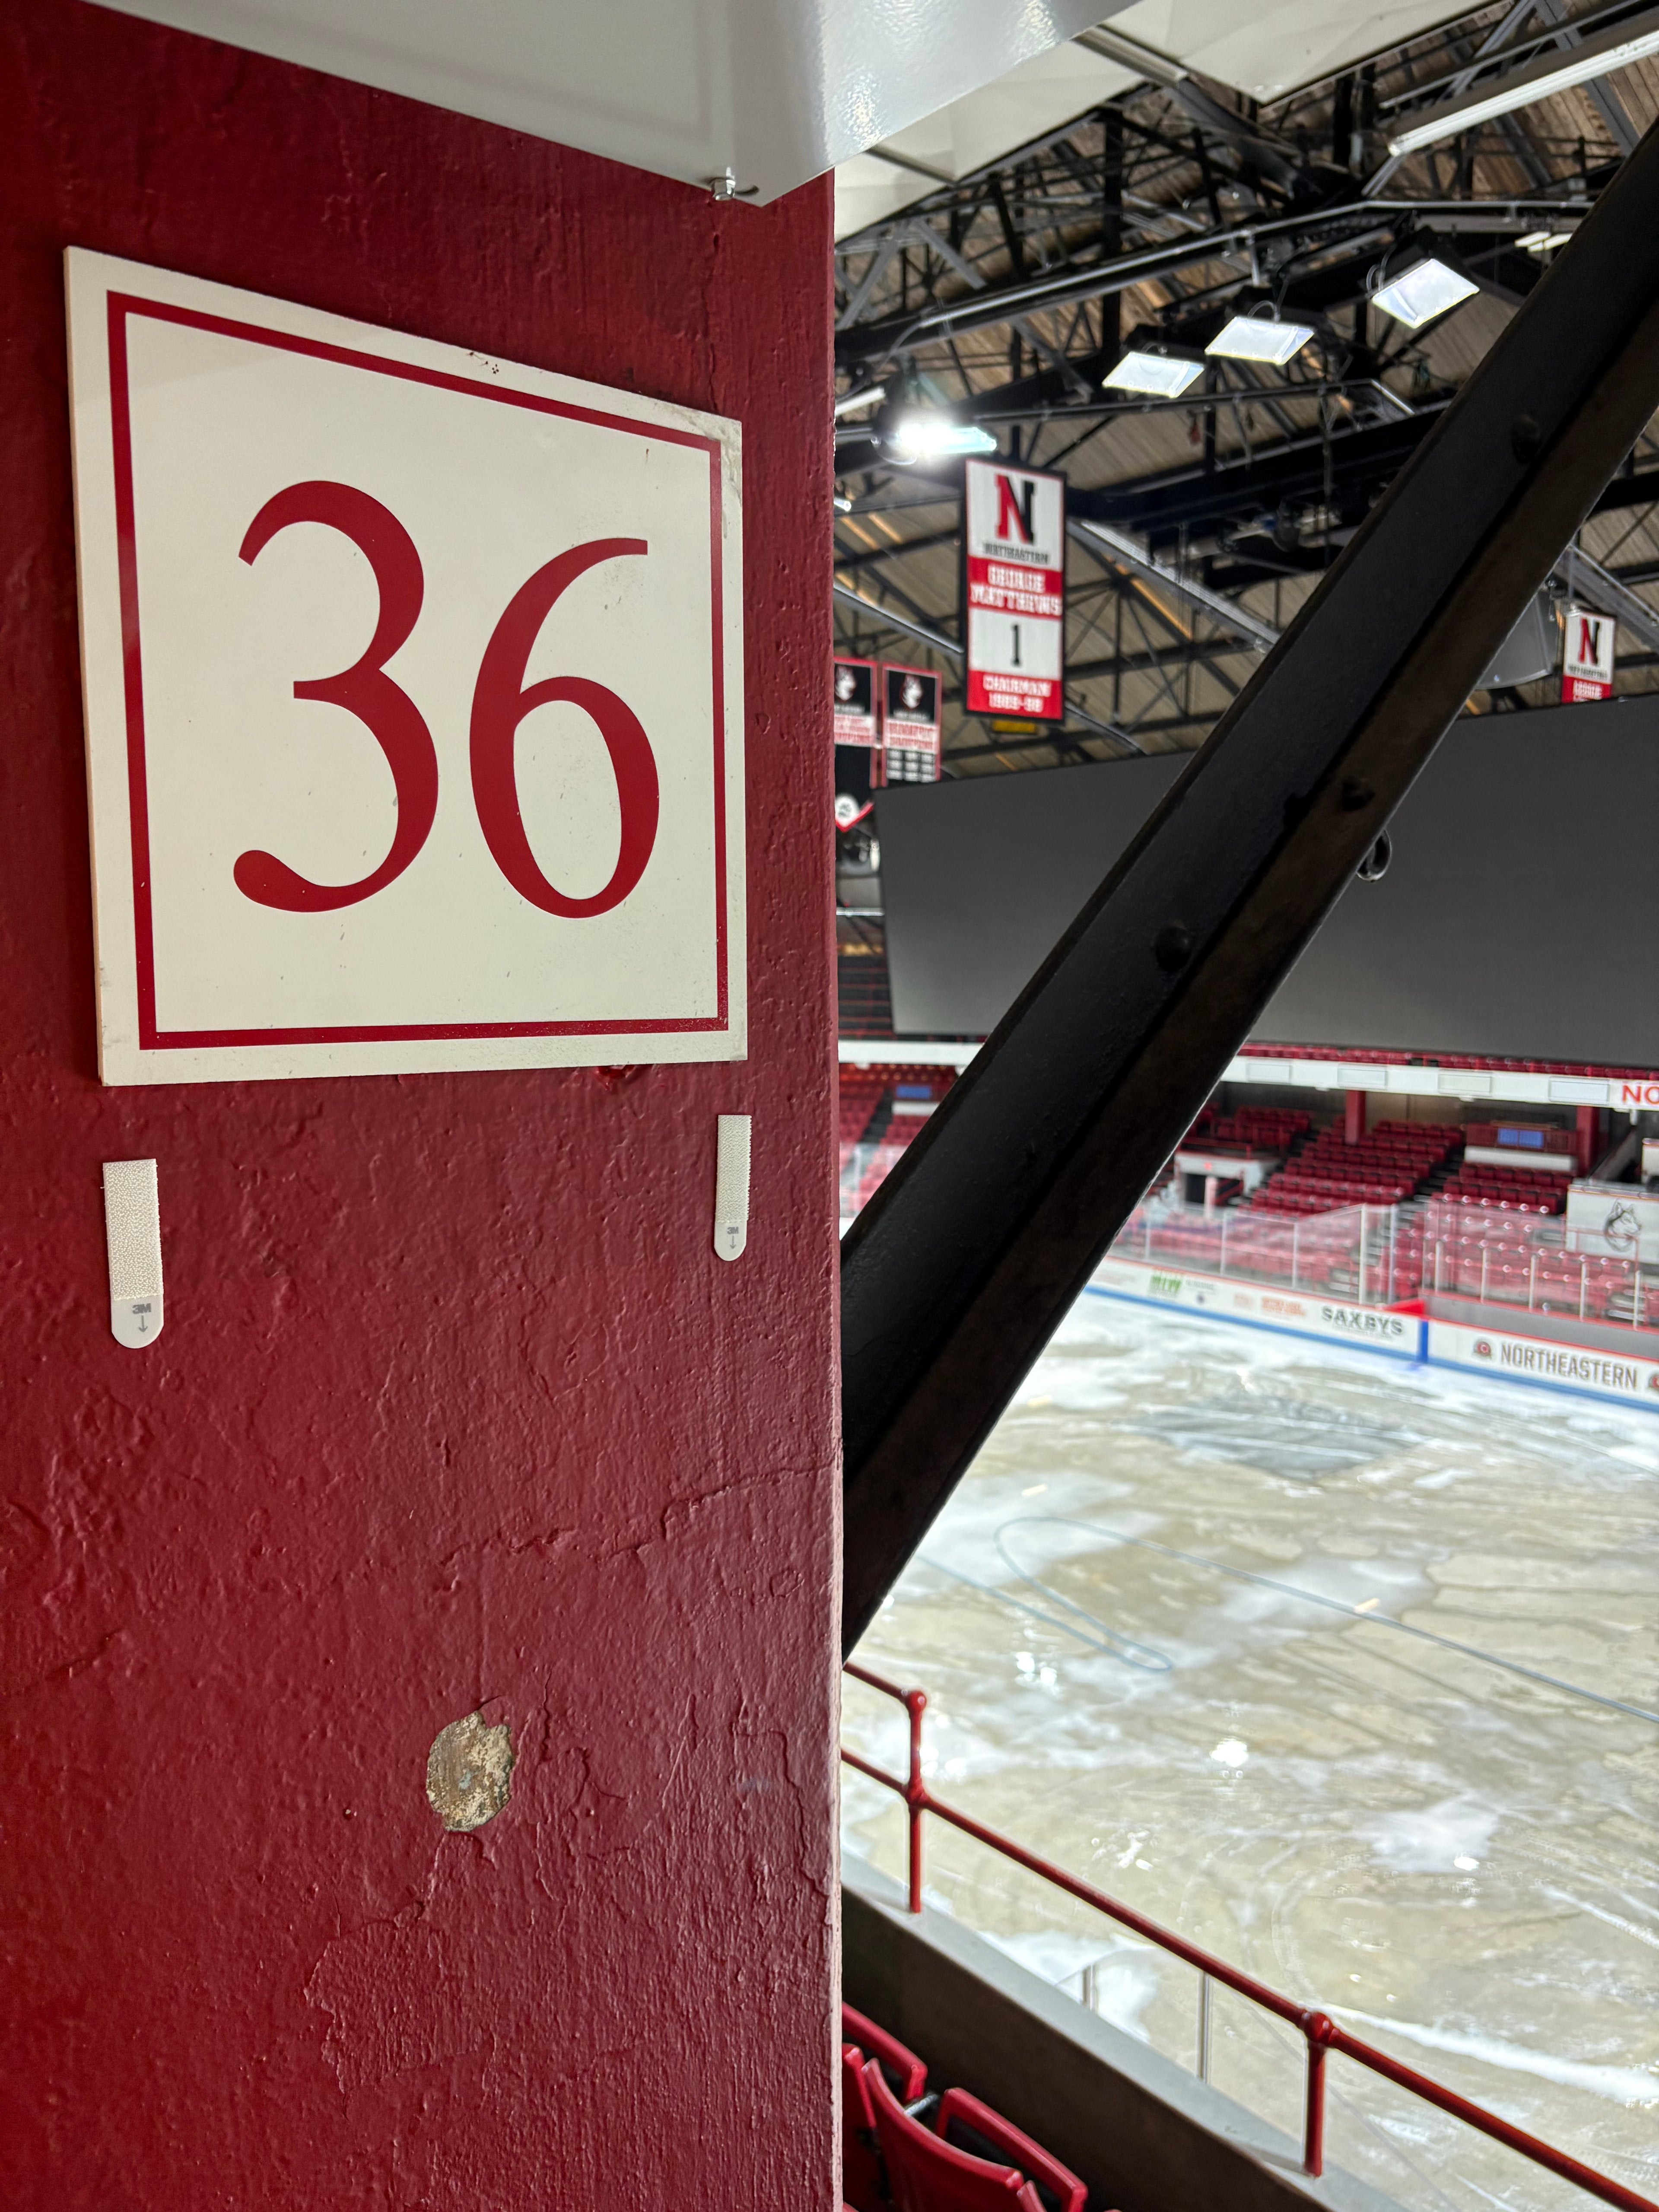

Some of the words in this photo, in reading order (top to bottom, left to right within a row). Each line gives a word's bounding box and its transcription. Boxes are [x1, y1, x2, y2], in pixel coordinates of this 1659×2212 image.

[995, 474, 1035, 545] N
[970, 583, 1062, 616] MATTHEWS
[1011, 623, 1021, 667] 1
[1578, 617, 1600, 666] N
[234, 480, 659, 918] 36
[1622, 1085, 1659, 1104] NO
[727, 1226, 739, 1235] 3M
[132, 1303, 152, 1314] 3M
[1322, 1306, 1404, 1335] SAXBYS
[1500, 1342, 1637, 1389] NORTHEASTERN
